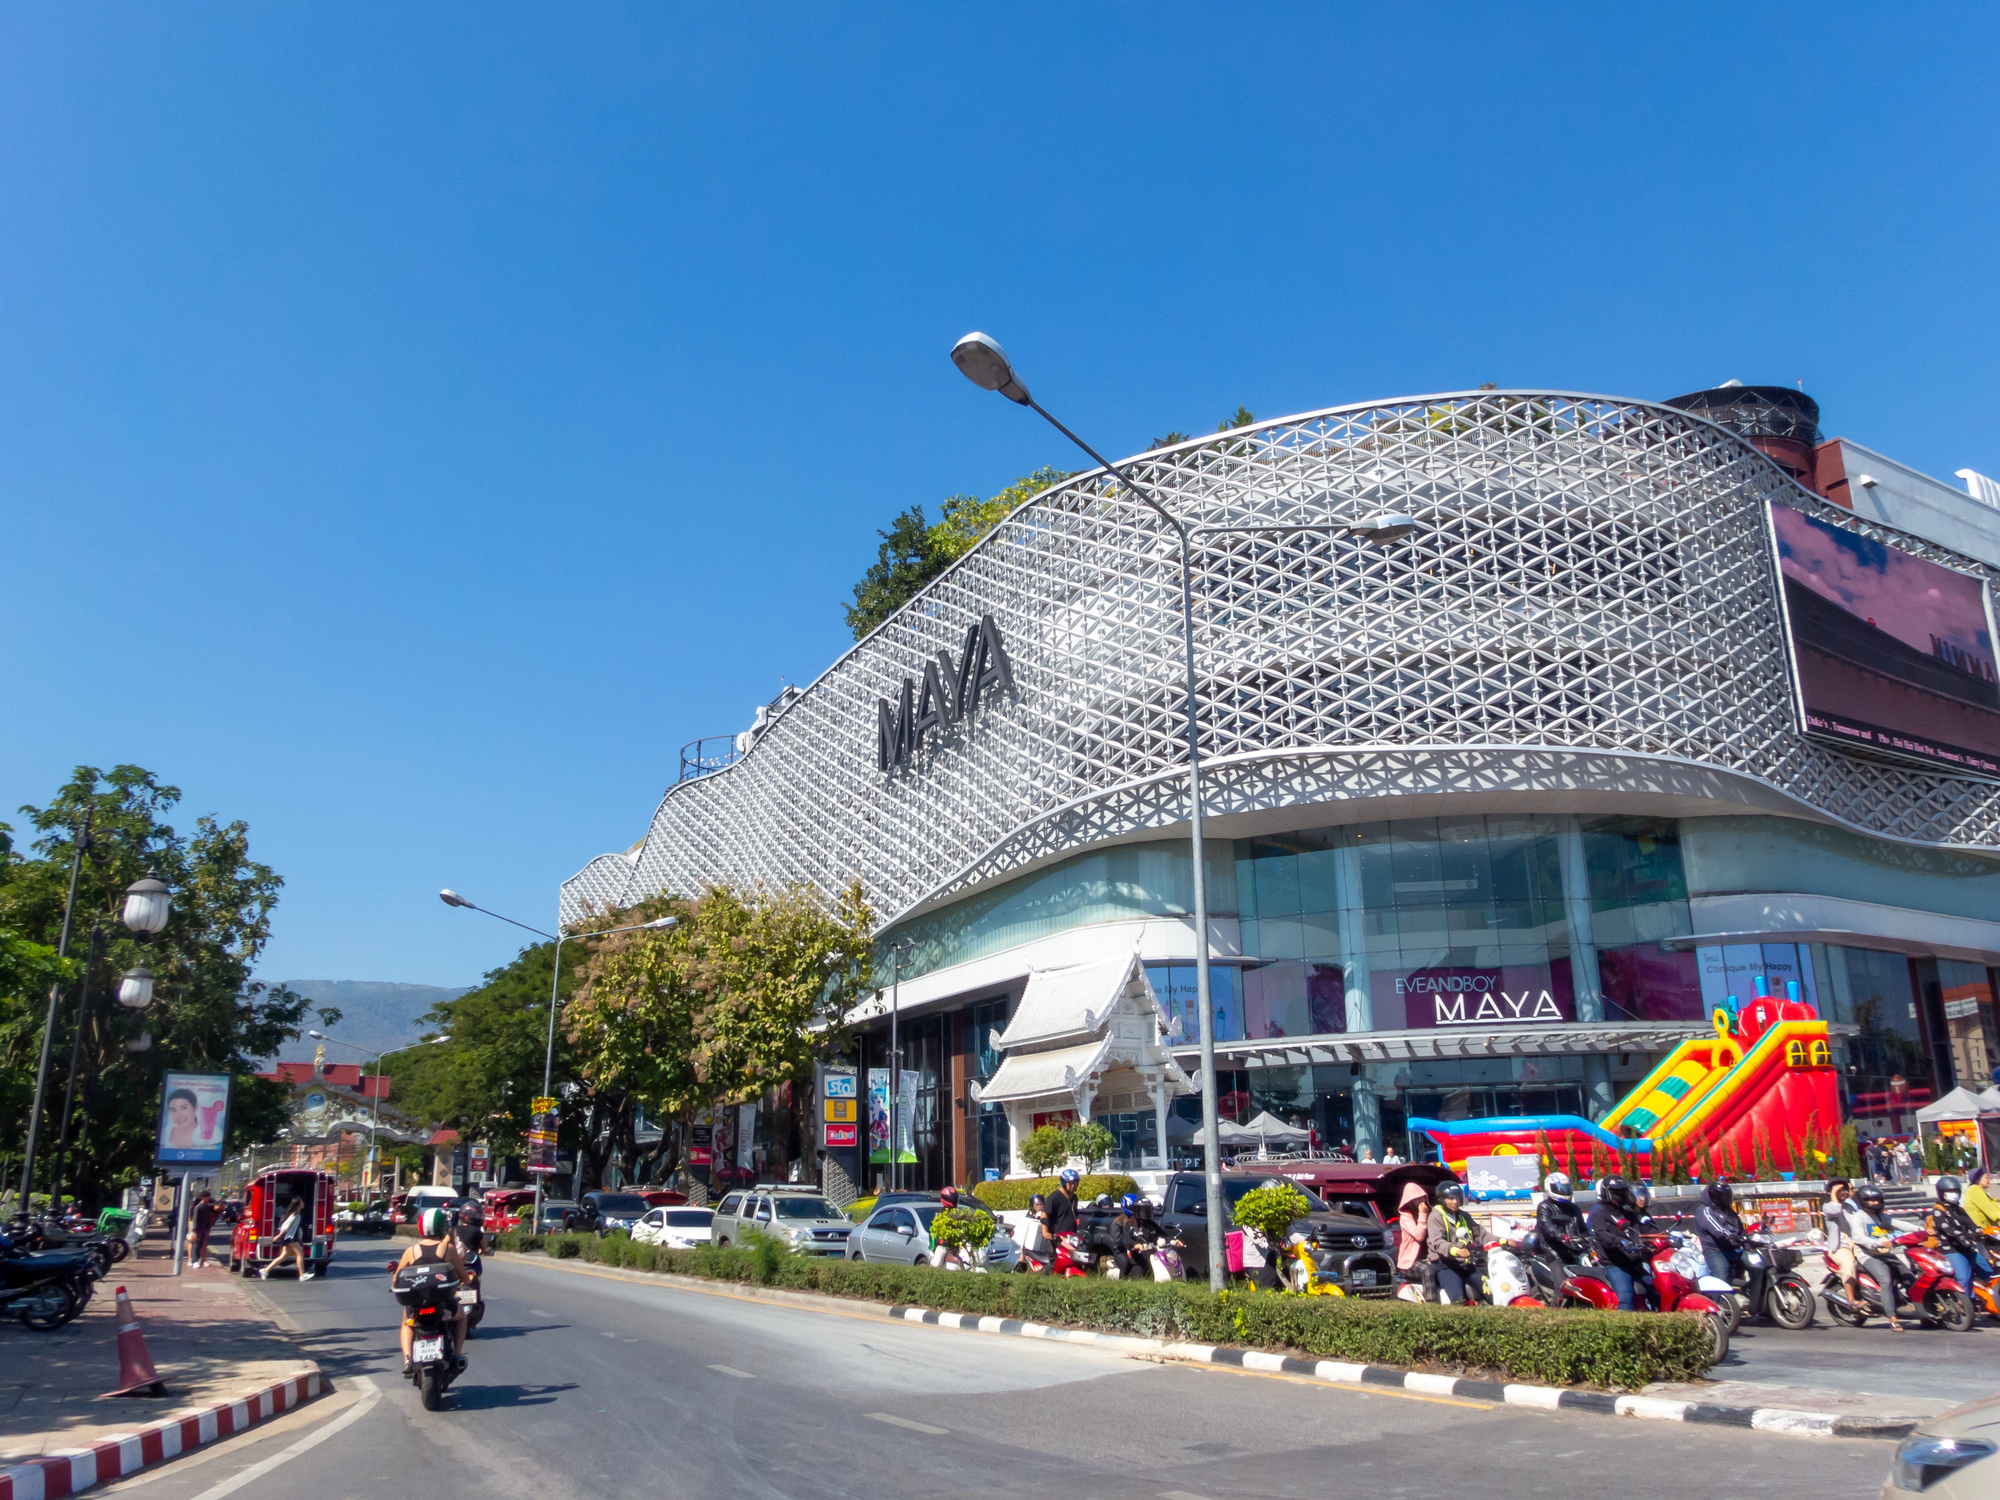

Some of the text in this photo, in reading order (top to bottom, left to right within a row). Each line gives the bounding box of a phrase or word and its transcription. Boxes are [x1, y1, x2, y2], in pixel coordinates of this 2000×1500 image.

[878, 615, 1011, 771] MAYA
[1706, 962, 1792, 974] Clinique My Happy
[1180, 985, 1198, 995] Hap
[1395, 975, 1497, 994] EVEANDBOY
[1434, 990, 1563, 1022] MAYA
[1512, 1156, 1535, 1166] MAYA
